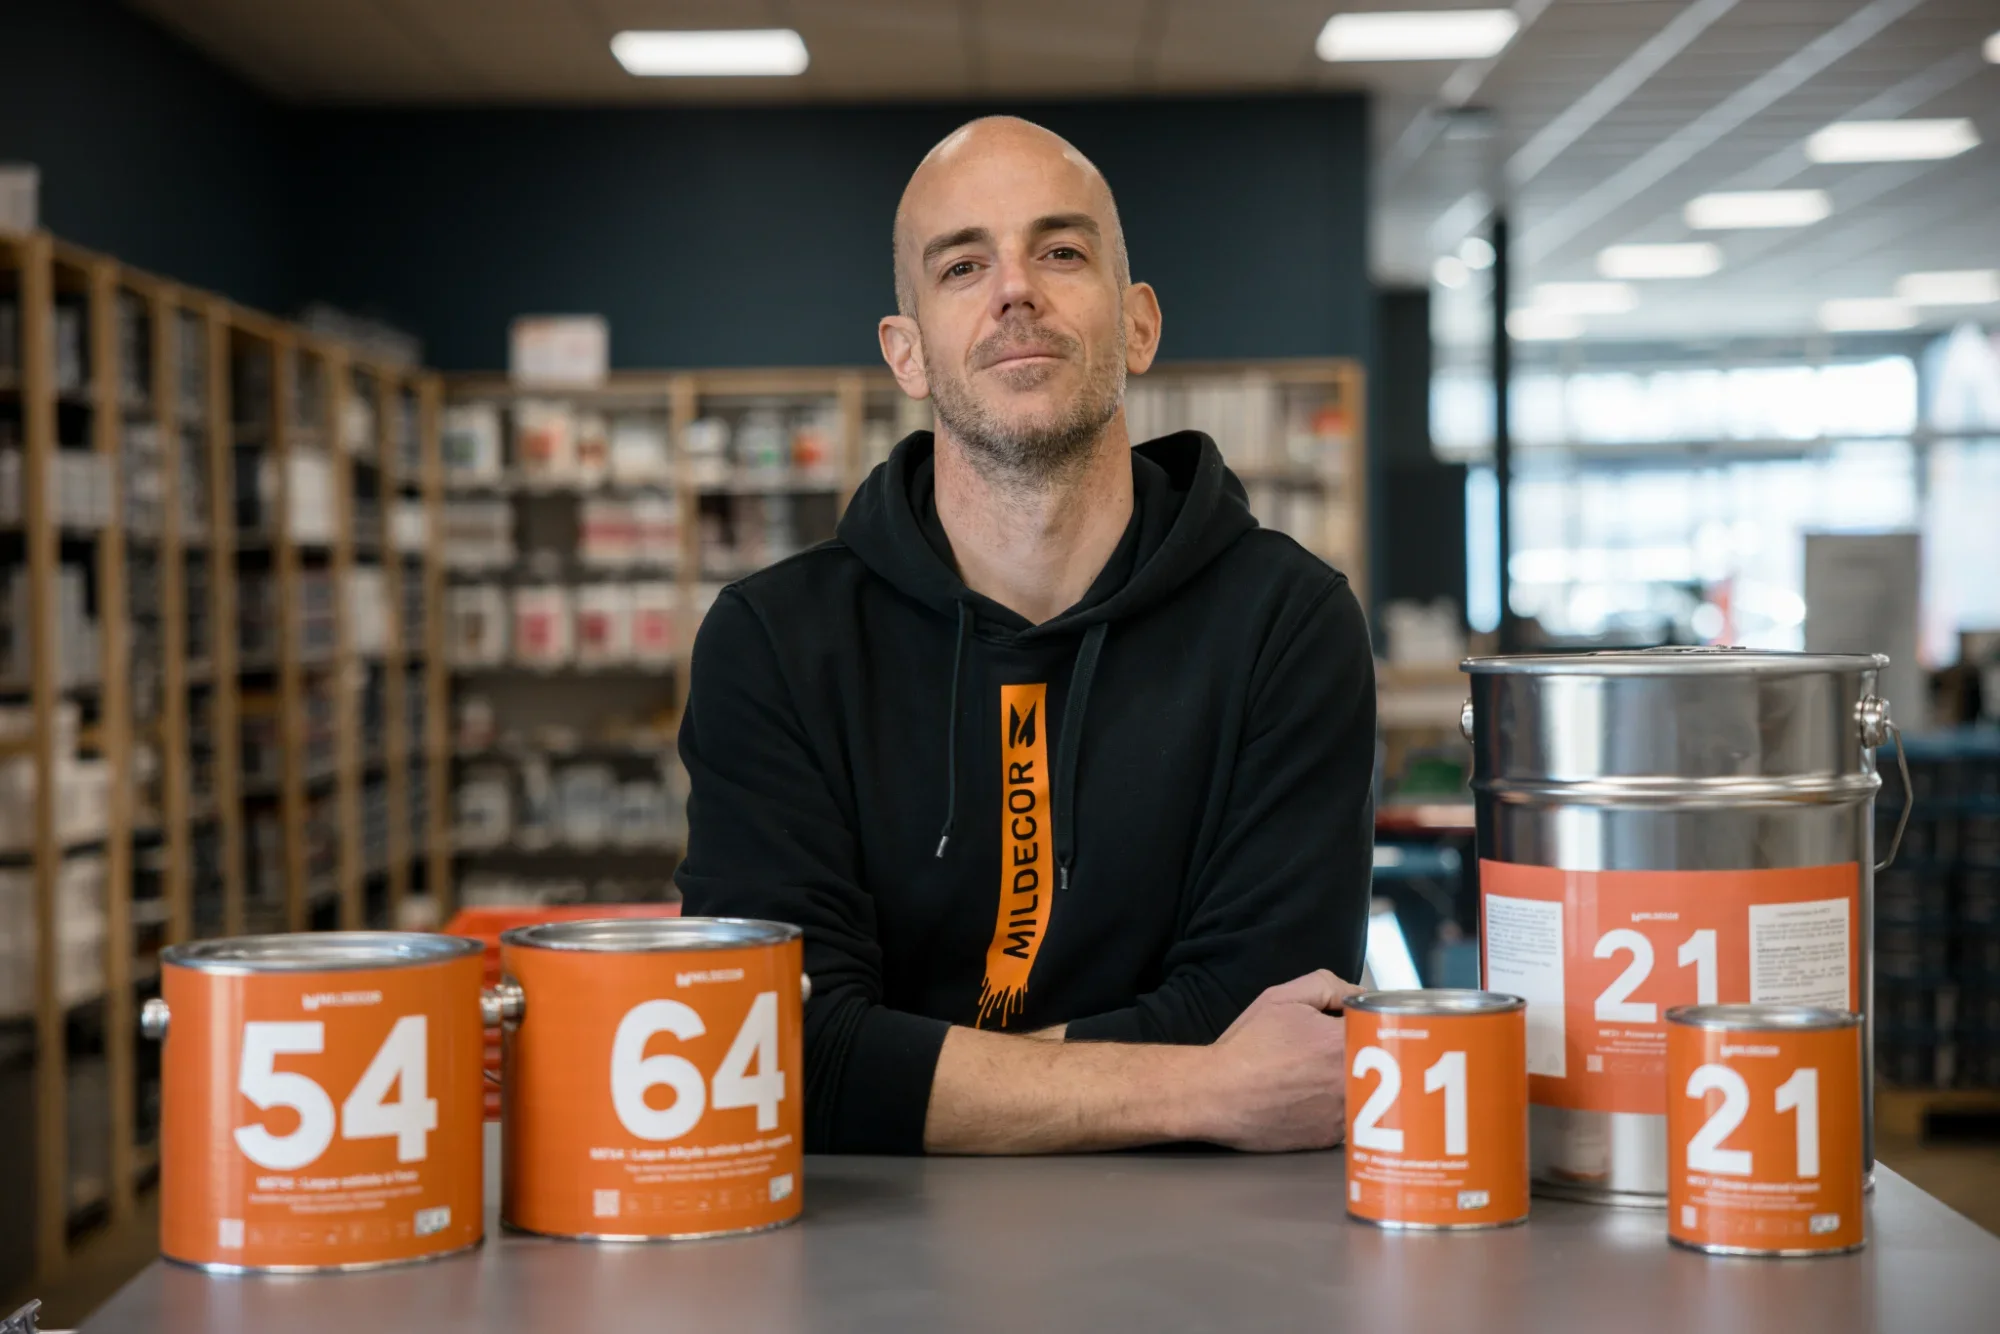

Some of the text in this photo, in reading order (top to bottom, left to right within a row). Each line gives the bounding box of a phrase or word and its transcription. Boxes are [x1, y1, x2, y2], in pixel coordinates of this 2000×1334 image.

[1002, 760, 1039, 960] MILDECOR
[1593, 927, 1718, 1023] 21
[233, 1014, 438, 1170] 54
[610, 991, 785, 1141] 64
[1352, 1046, 1468, 1156] 21
[1686, 1063, 1820, 1179] 21
